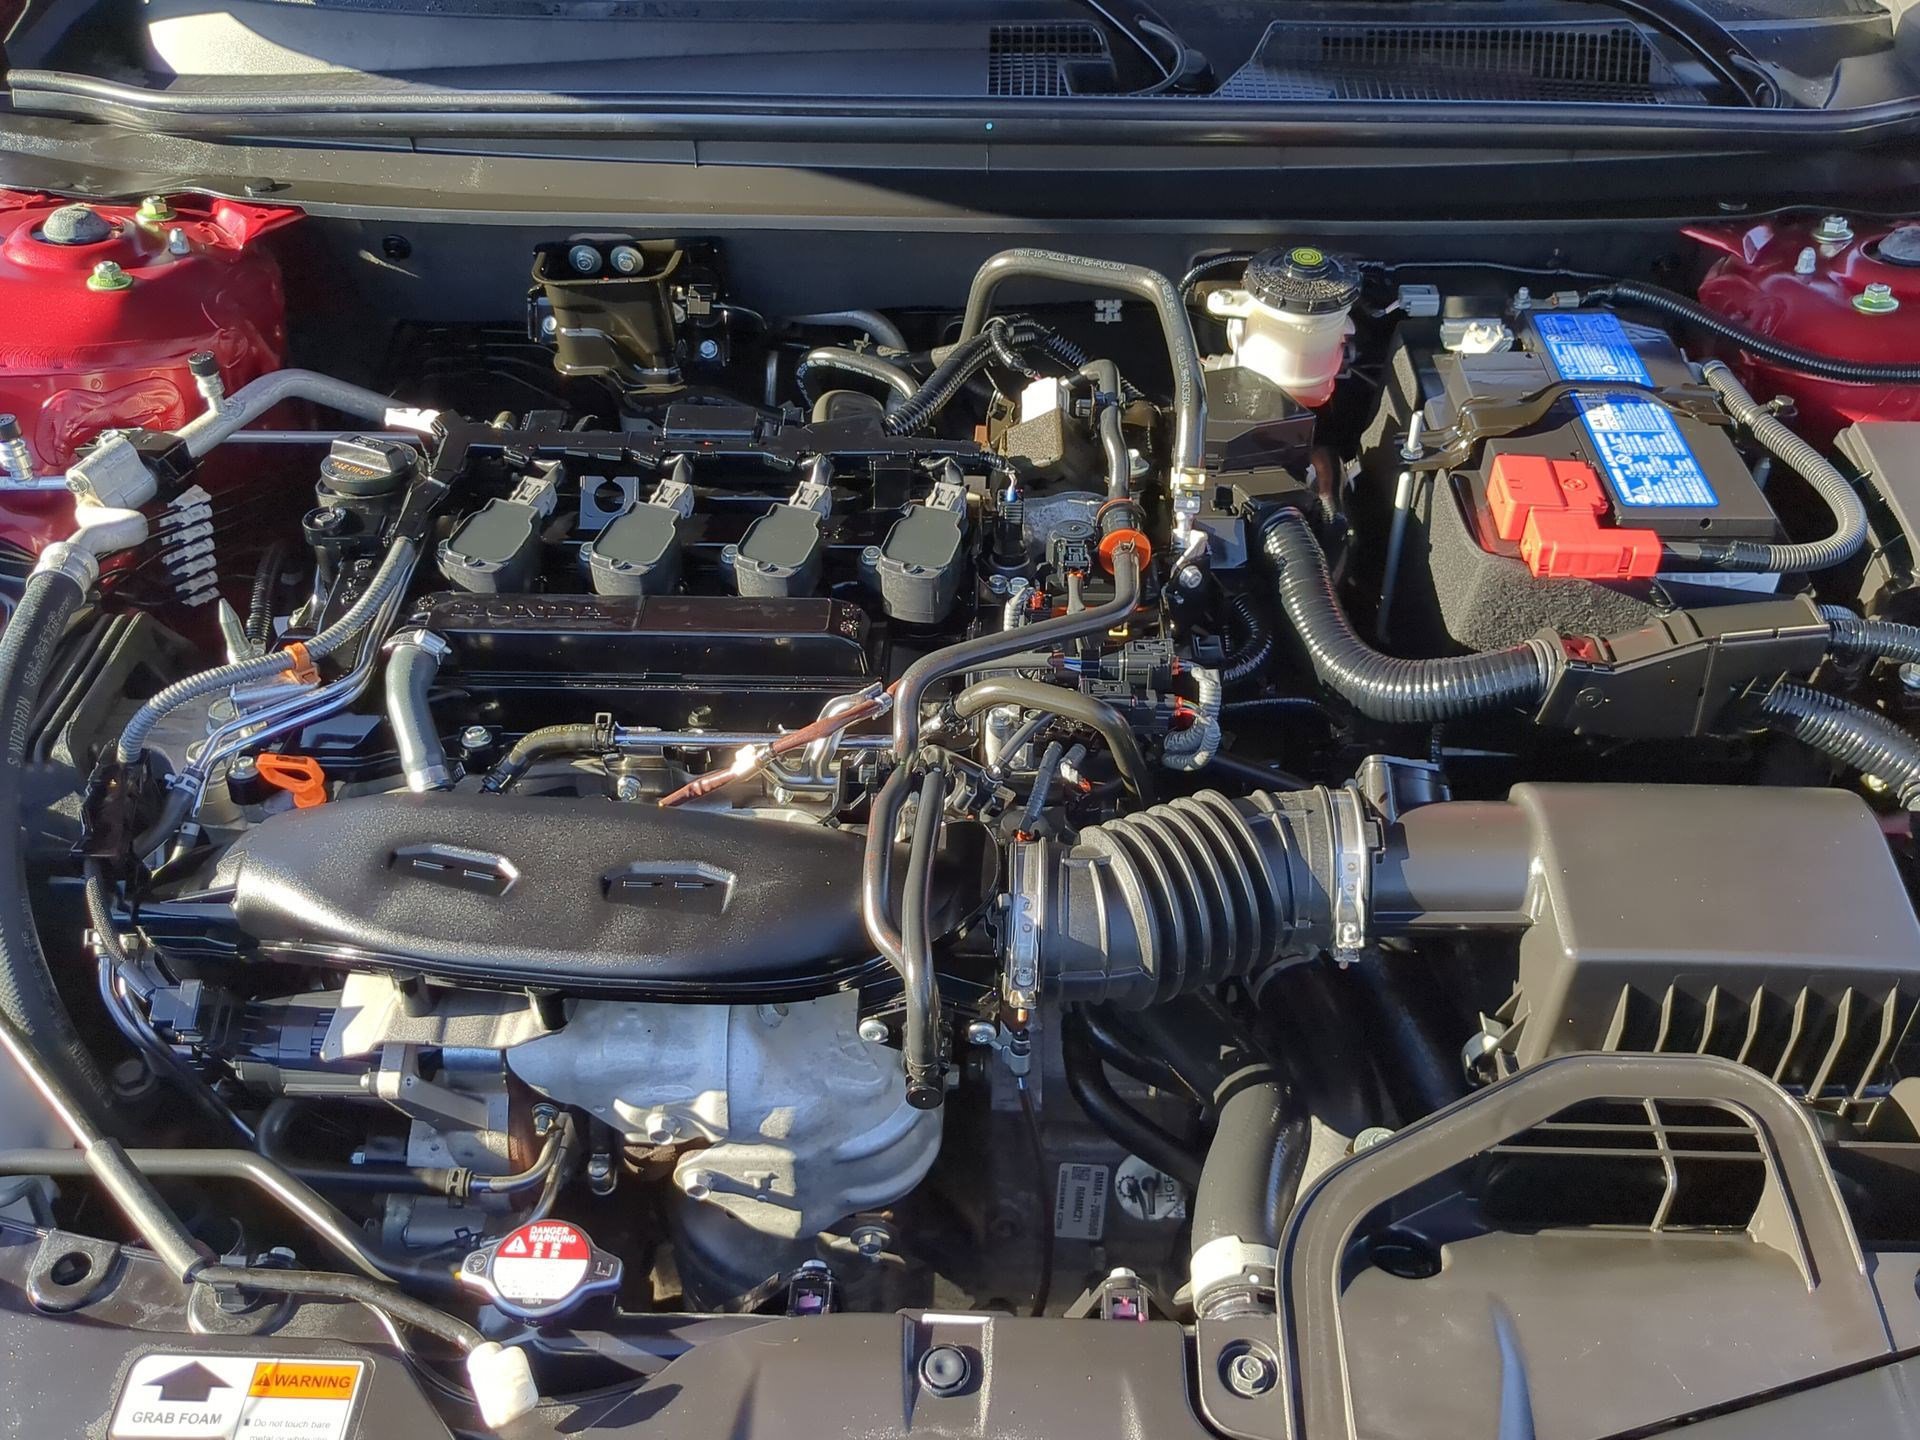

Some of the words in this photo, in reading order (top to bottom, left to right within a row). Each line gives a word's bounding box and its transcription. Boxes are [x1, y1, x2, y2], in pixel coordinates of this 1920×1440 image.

[450, 603, 612, 619] HONDA
[8, 695, 31, 756] NICHIRIN
[531, 1226, 569, 1235] DANGER
[274, 1374, 351, 1388] WARNING
[132, 1412, 175, 1424] GRAB
[178, 1412, 222, 1425] FOAM
[254, 1418, 266, 1427] Do
[268, 1420, 283, 1428] not
[284, 1420, 309, 1428] touch
[310, 1420, 331, 1429] bare
